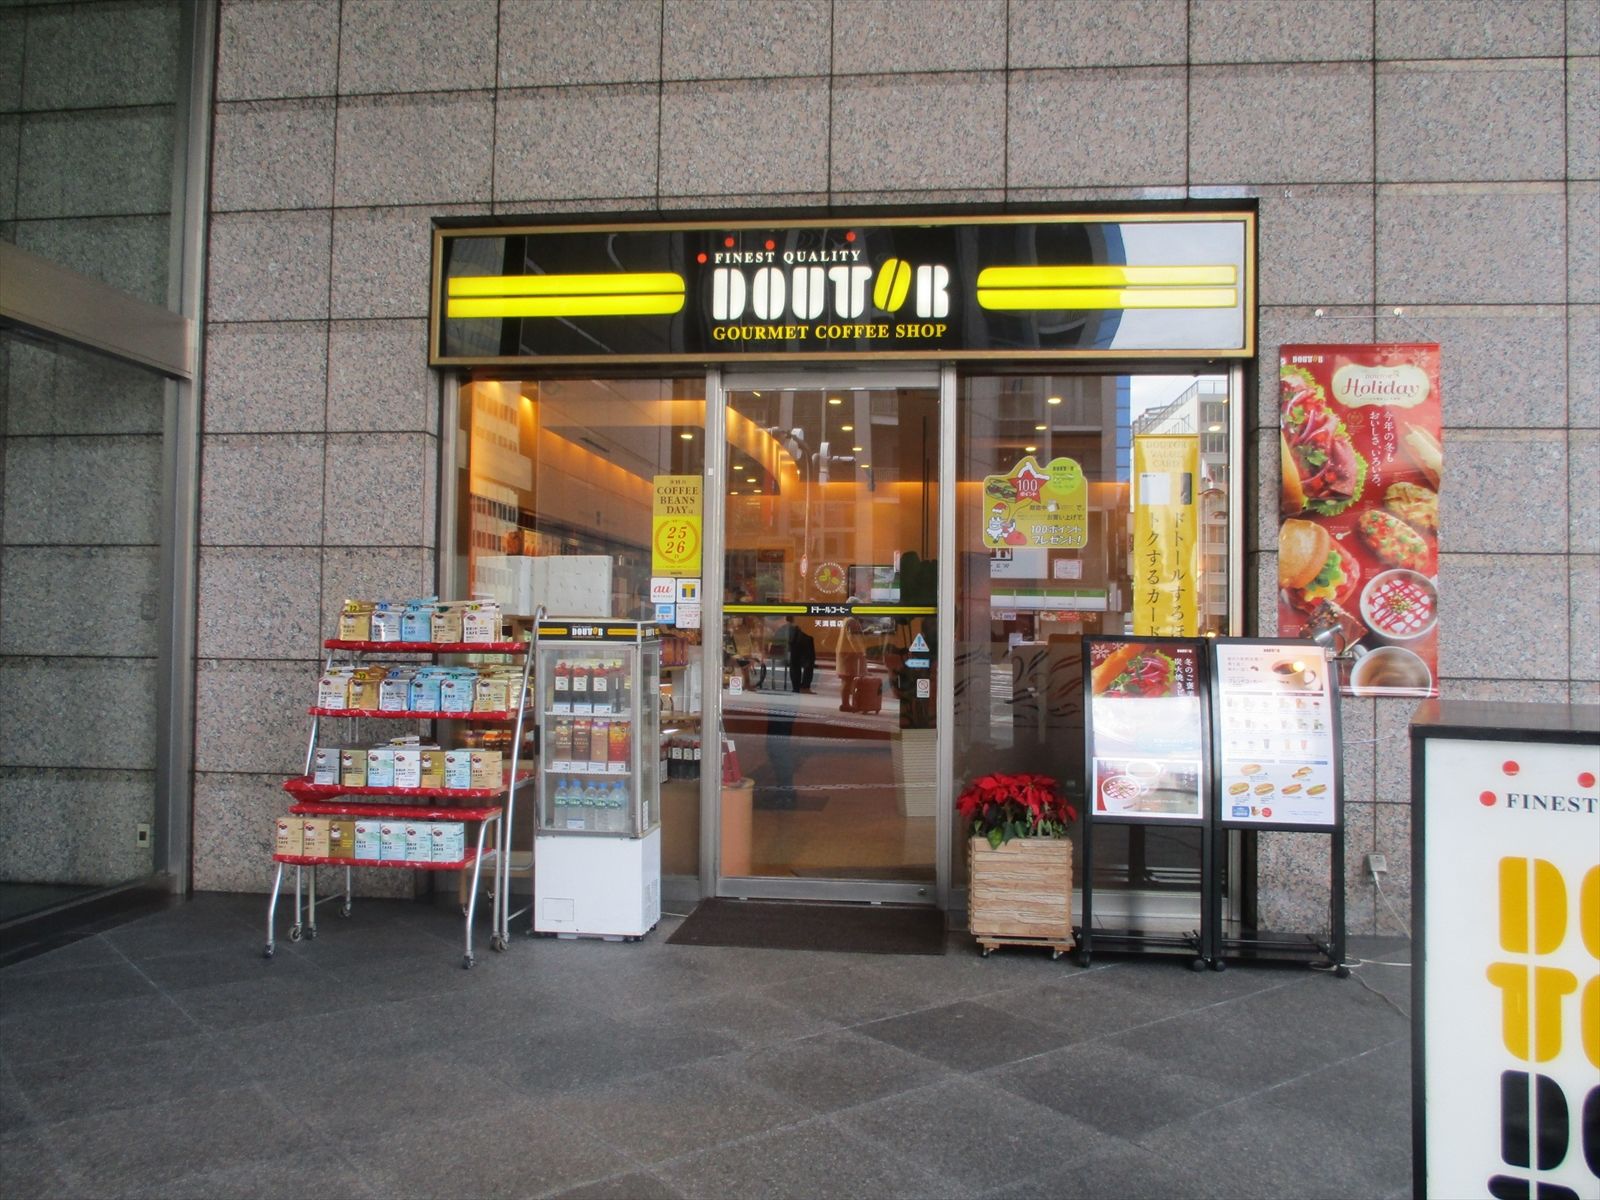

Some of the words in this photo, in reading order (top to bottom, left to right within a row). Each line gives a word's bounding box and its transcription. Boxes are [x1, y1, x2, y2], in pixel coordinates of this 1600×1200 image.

[714, 252, 775, 264] FINEST
[783, 250, 861, 264] QUALITY
[713, 258, 949, 320] DOUTOR
[713, 326, 808, 340] GOURMET
[815, 324, 889, 339] COFFEE
[895, 323, 947, 338] SHOP
[1341, 378, 1419, 398] Holiday
[1383, 411, 1395, 462] 今年の冬も
[657, 486, 699, 495] COFFEE
[1018, 479, 1038, 491] 100
[660, 496, 695, 504] BEANS
[666, 506, 688, 514] DAY
[667, 526, 687, 539] 25
[665, 541, 685, 554] 26
[653, 583, 672, 593] au
[811, 606, 849, 614] ドトールコーヒー
[1505, 792, 1598, 814] FINEST
[1498, 855, 1600, 960] D
[1486, 961, 1600, 1070] T
[1500, 1069, 1600, 1179] D
